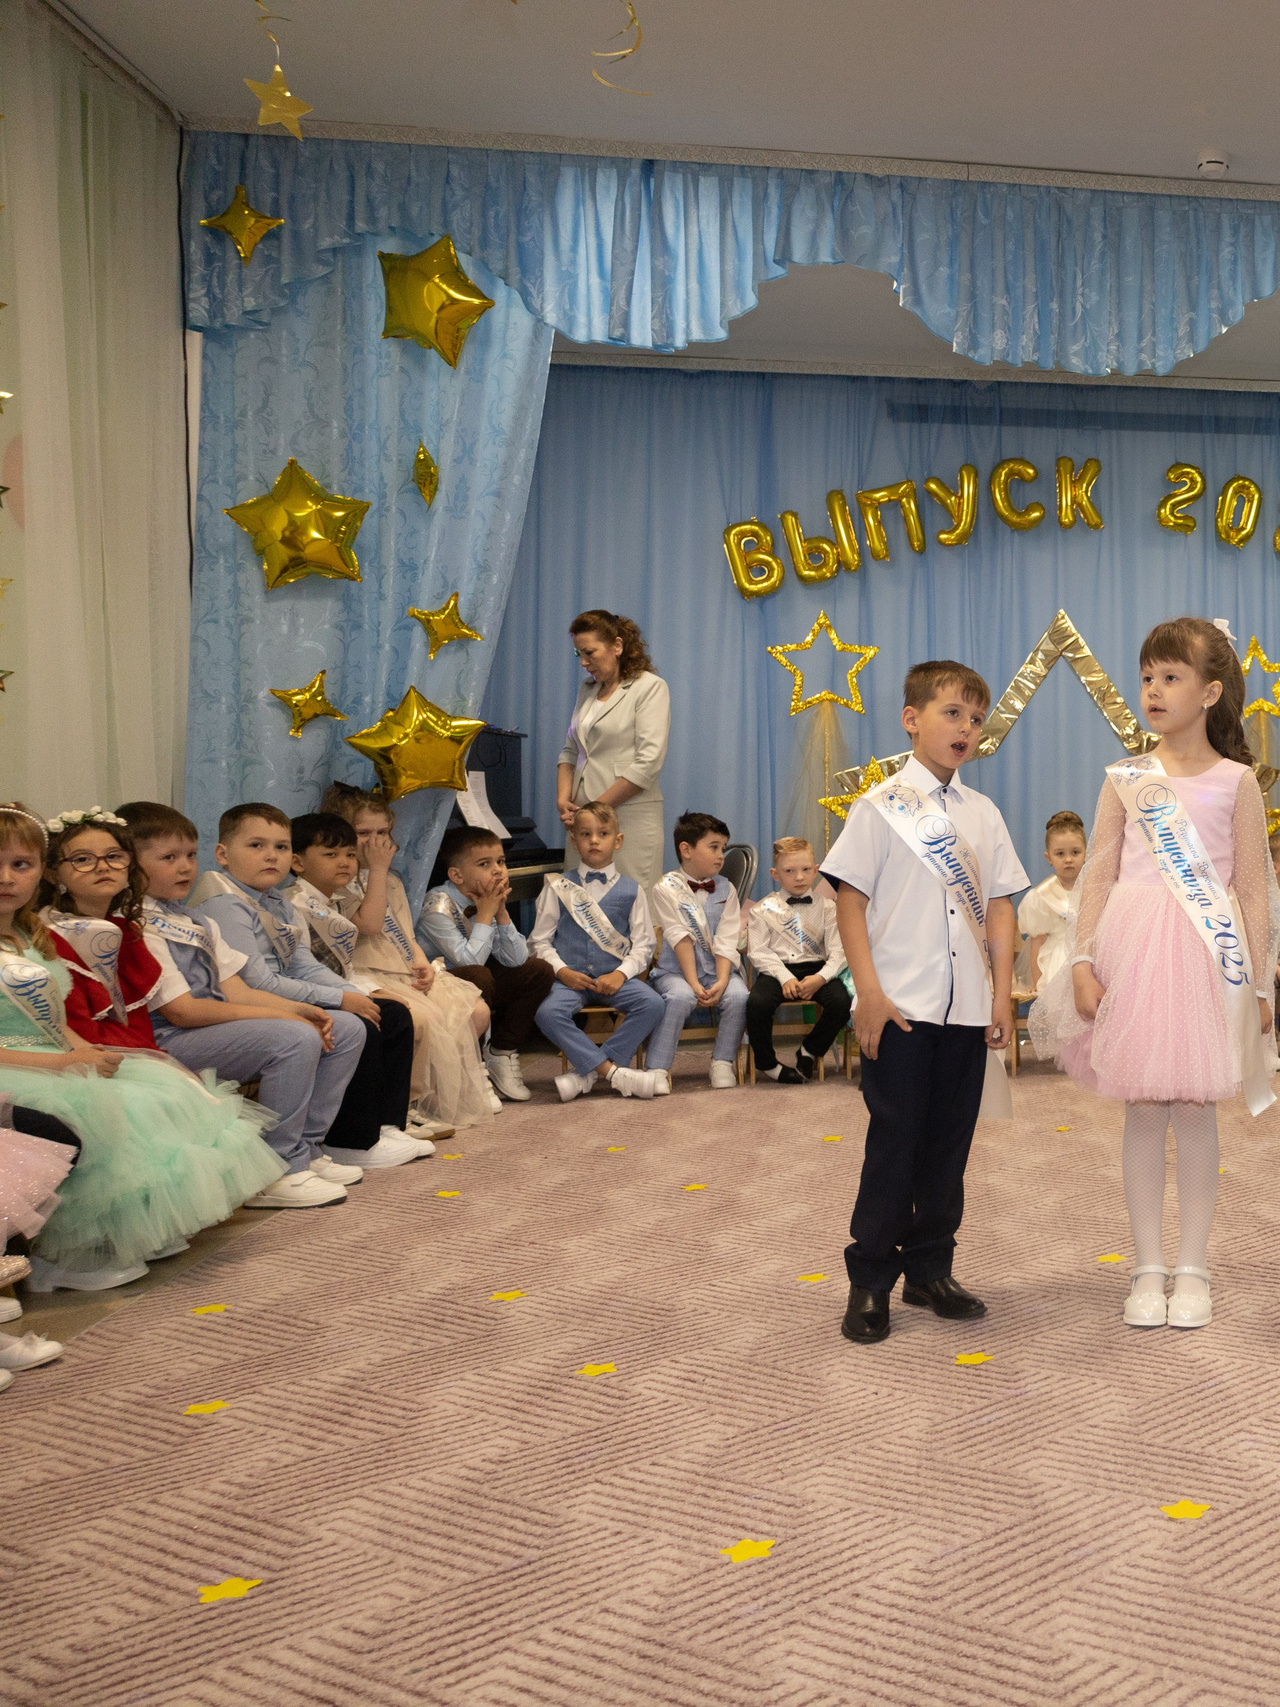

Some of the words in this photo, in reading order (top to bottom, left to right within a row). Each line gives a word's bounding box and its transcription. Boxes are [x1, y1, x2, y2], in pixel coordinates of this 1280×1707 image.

[723, 456, 1104, 599] ВЫПУСК
[915, 814, 986, 927] Выпускник
[1135, 783, 1213, 910] Выпускница
[1201, 914, 1252, 987] 2025
[1197, 861, 1221, 901] Вероника
